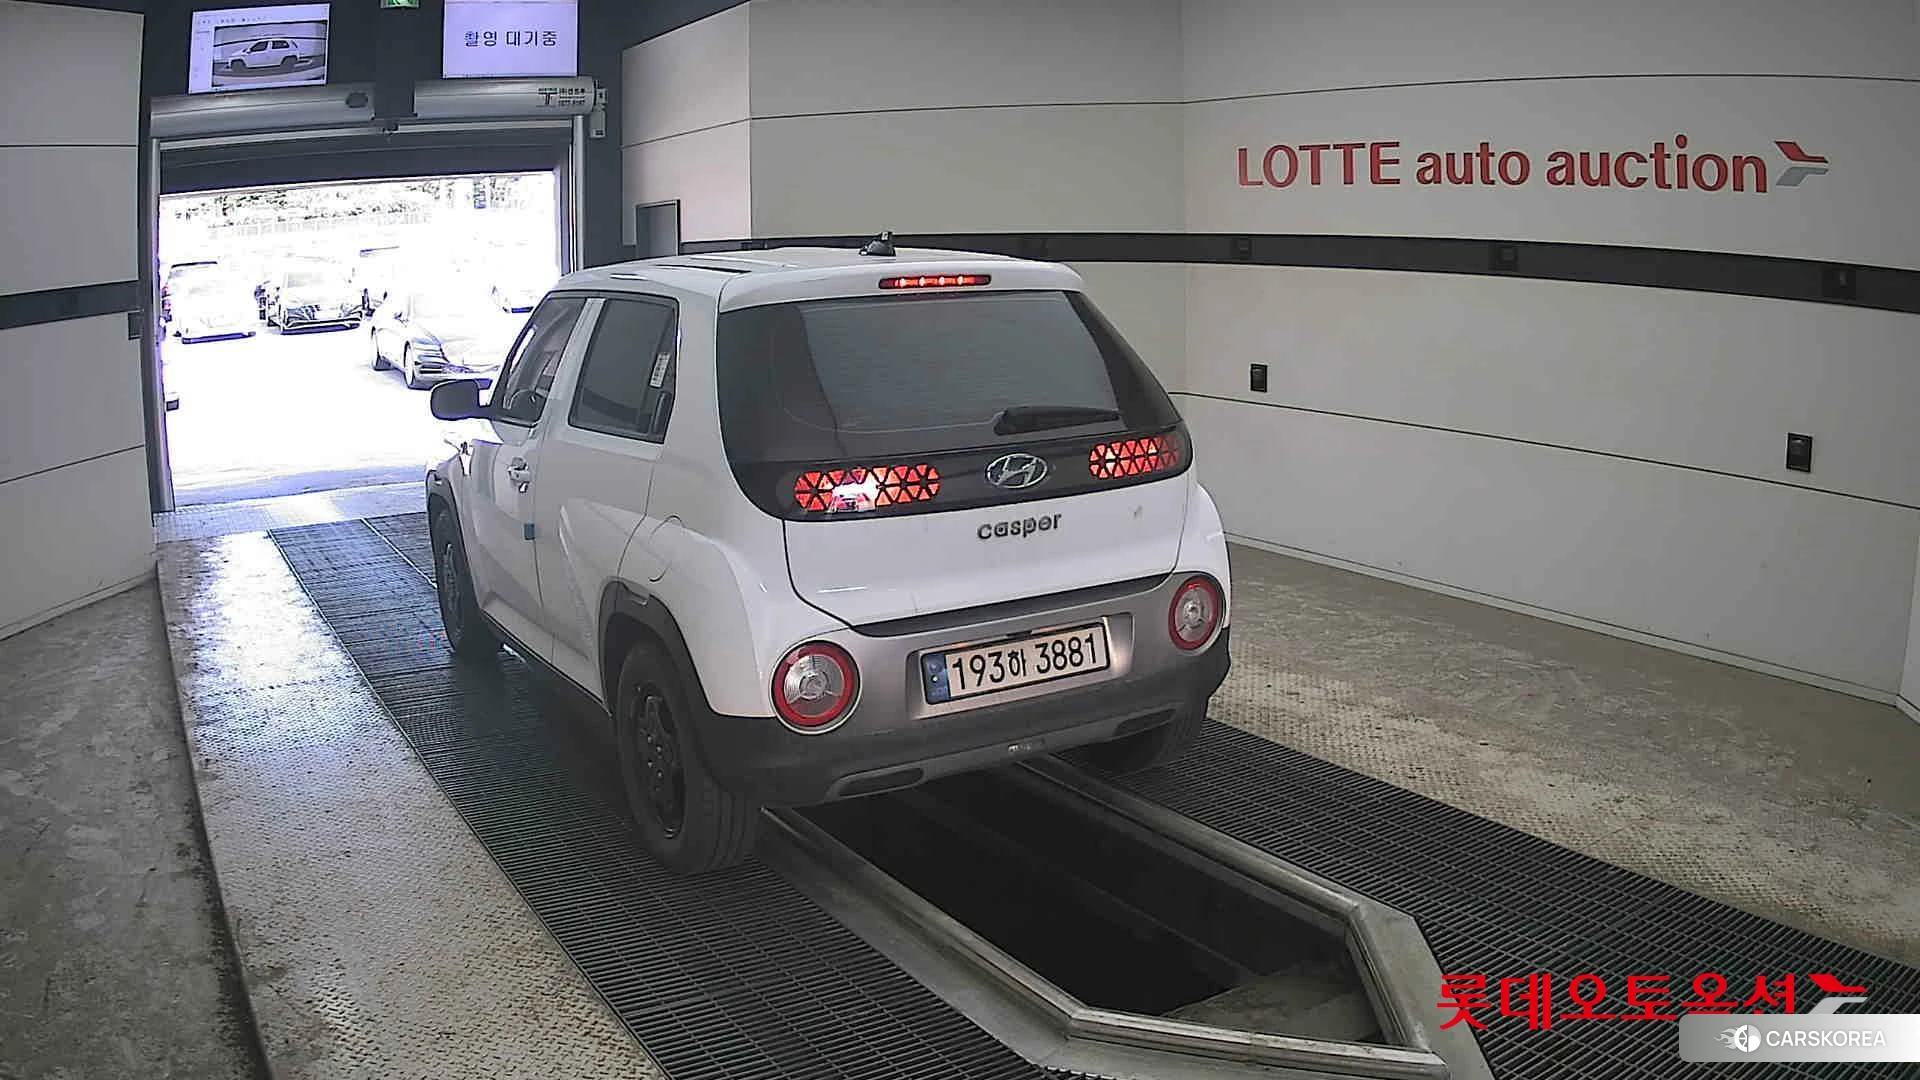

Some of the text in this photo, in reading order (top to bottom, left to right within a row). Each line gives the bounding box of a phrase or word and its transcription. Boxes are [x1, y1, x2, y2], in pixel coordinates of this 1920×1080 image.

[505, 30, 558, 47] 대기중
[1238, 134, 1768, 193] LOTTE auto auction
[977, 512, 1062, 540] casper
[952, 632, 1097, 690] 193하 3881
